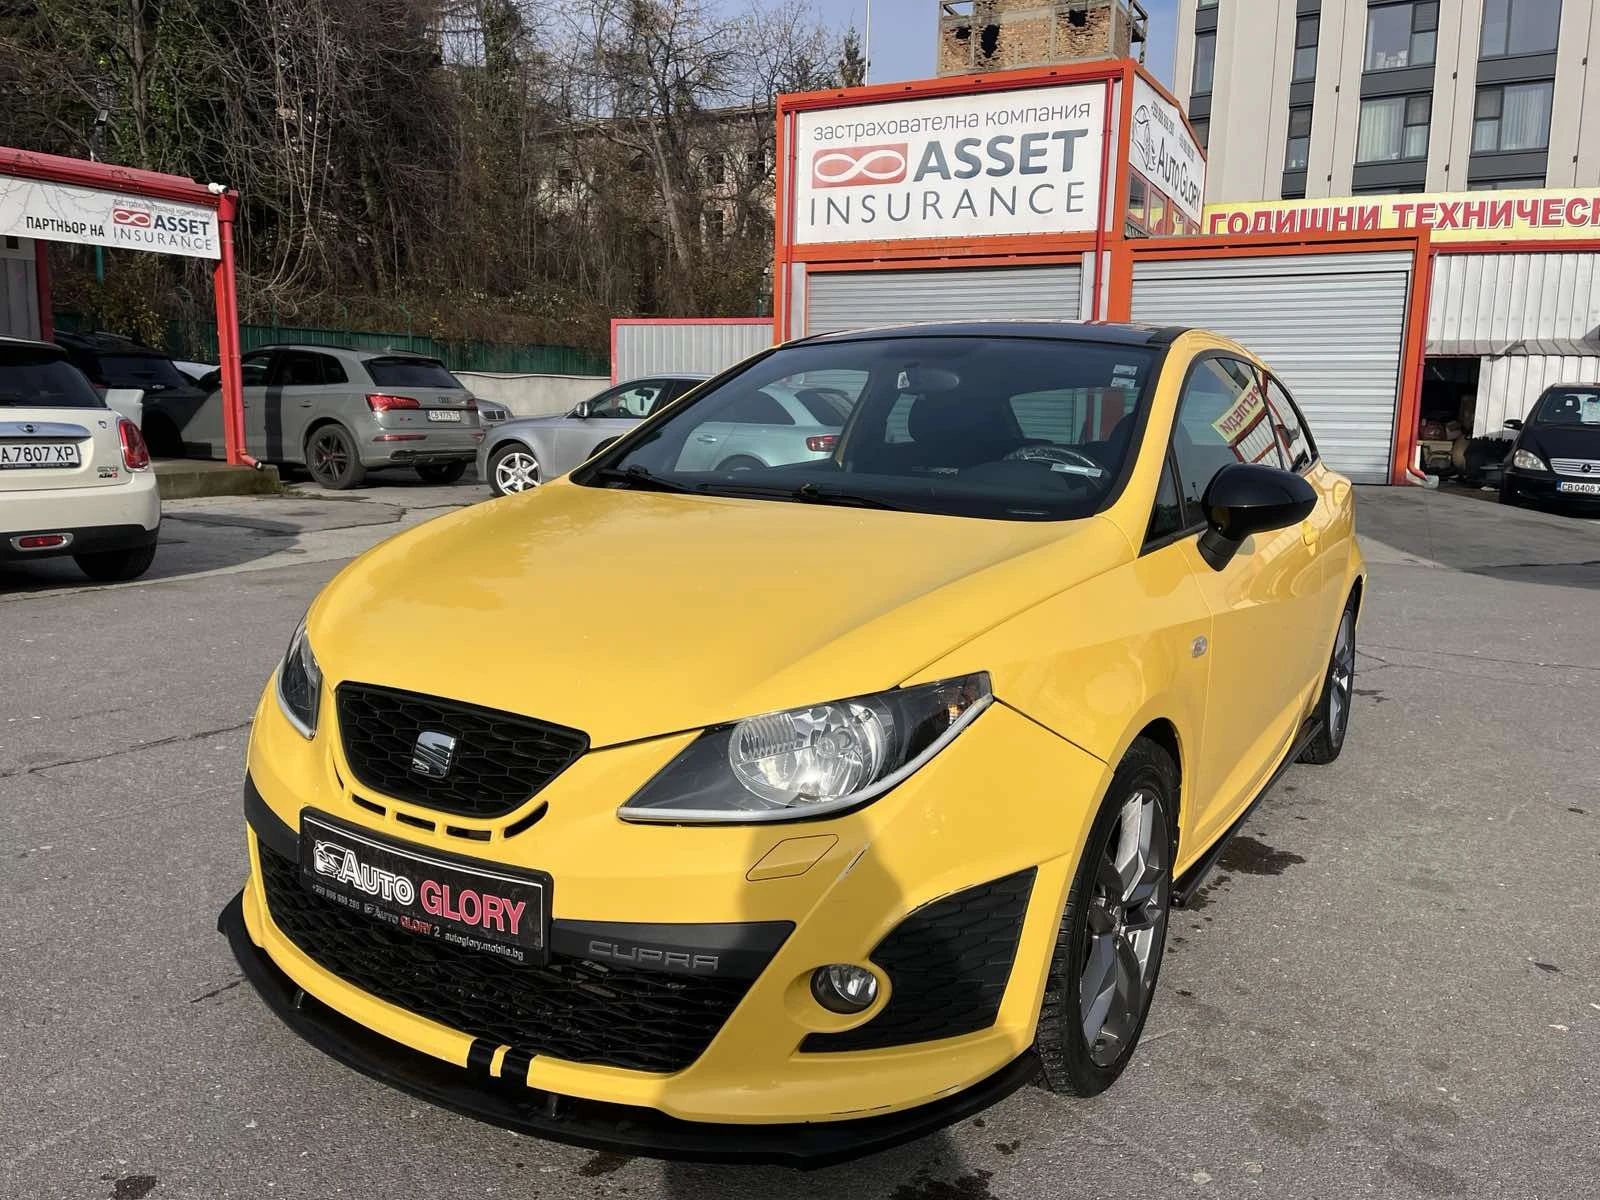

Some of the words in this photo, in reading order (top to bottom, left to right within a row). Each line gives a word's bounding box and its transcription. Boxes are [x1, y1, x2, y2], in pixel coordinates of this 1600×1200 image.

[812, 113, 979, 142] застрахователна
[985, 103, 1091, 127] компания
[912, 128, 1089, 182] ASSET
[809, 180, 1086, 227] INSURANCE
[26, 216, 87, 236] ПАРТНЬОР
[90, 223, 105, 238] НА
[153, 214, 210, 236] ASSET
[1209, 205, 1380, 235] ГОДИШНИ
[113, 226, 213, 251] INSURANCE
[12, 446, 51, 462] 7807
[53, 446, 74, 461] XP
[420, 879, 526, 935] GLORY
[433, 925, 441, 937] 2
[444, 931, 524, 961] autoglory.mobile.bg
[588, 940, 719, 972] CUPRA
